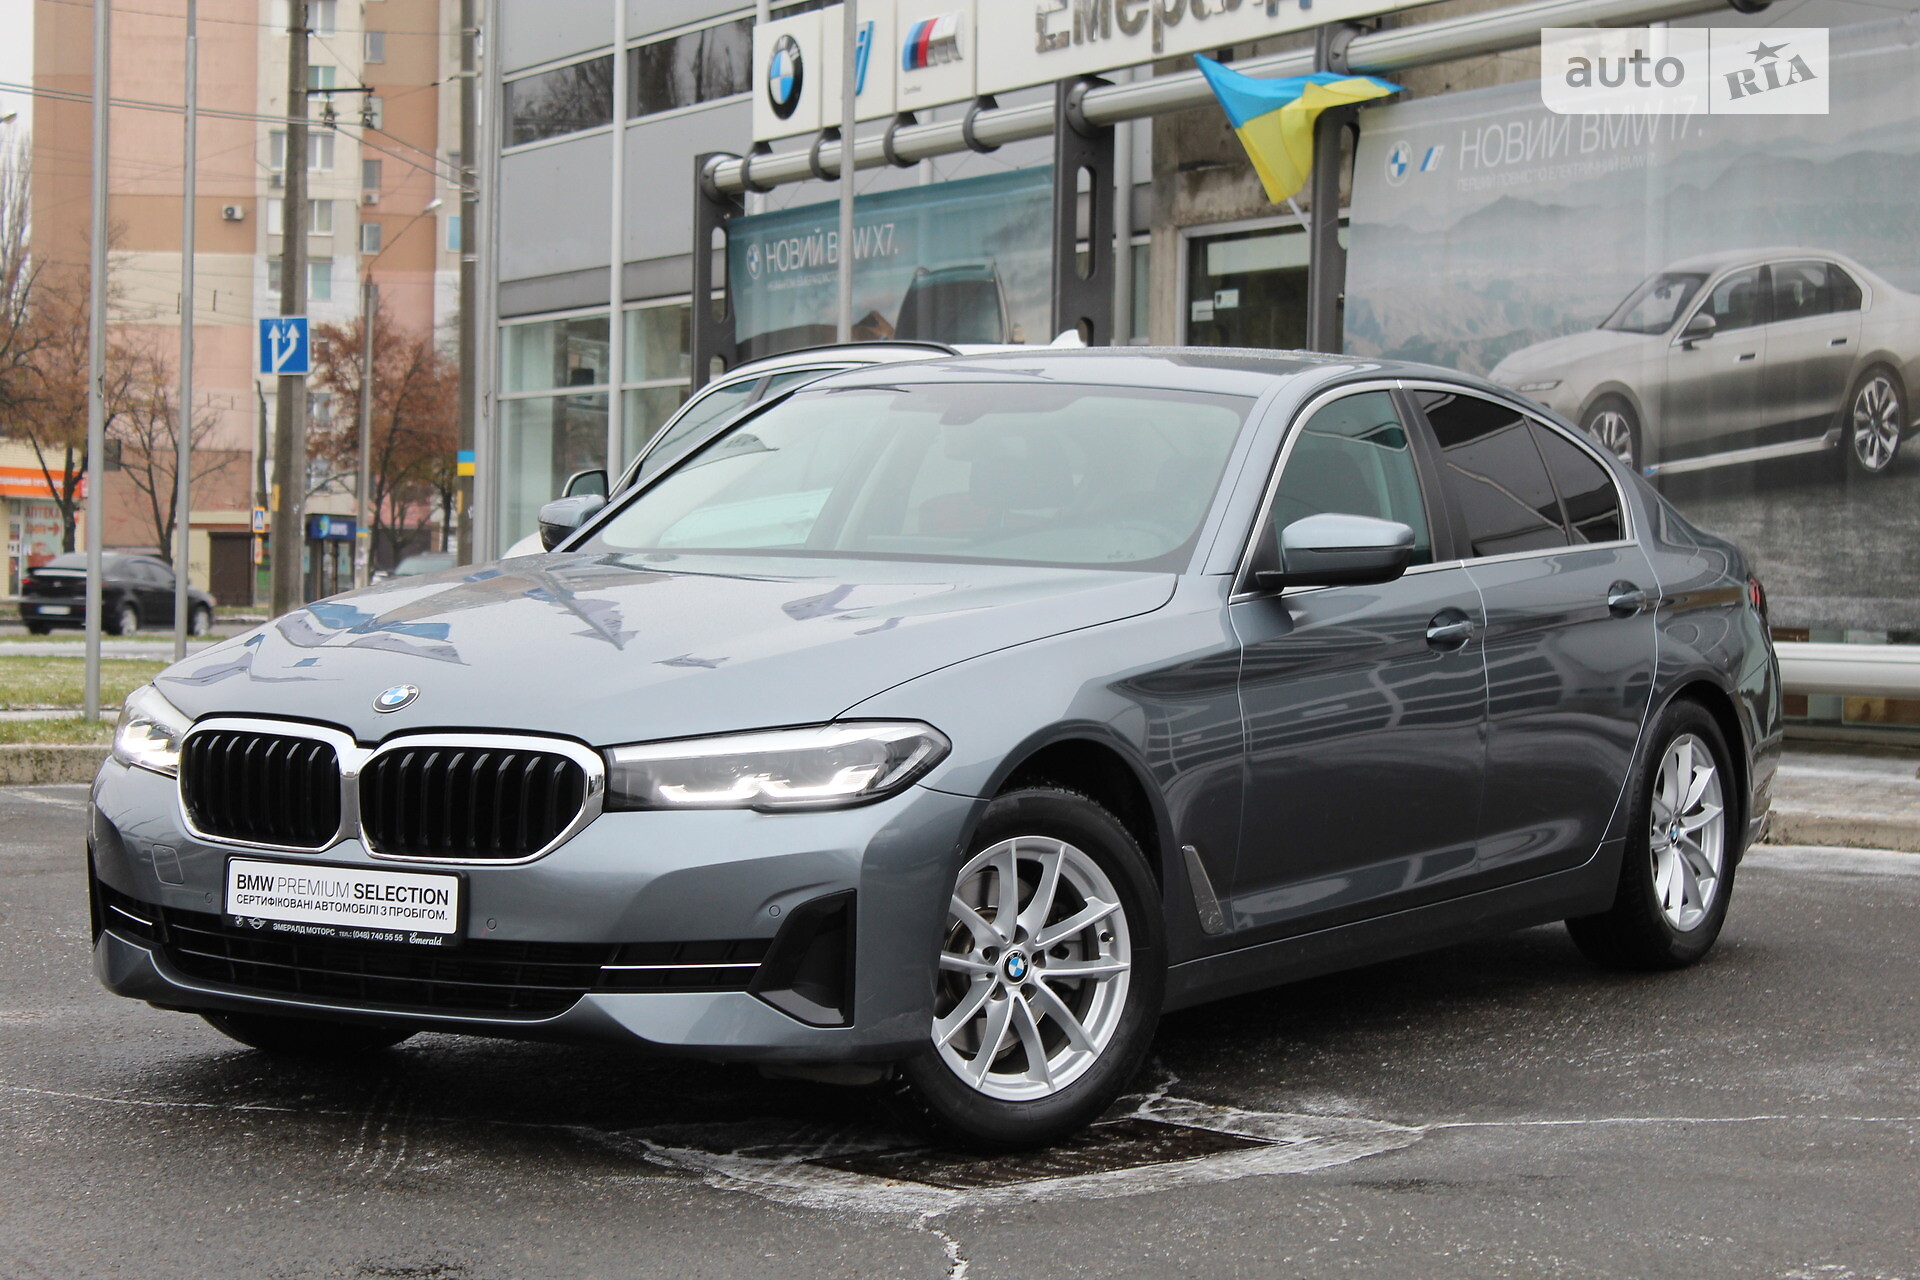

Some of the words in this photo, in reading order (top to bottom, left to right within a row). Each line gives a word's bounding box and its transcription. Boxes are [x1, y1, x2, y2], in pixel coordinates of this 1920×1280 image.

[1035, 0, 1312, 53] Емер
[1580, 95, 1662, 154] BMW
[766, 228, 824, 274] НОВИЙ
[827, 225, 871, 264] BW
[236, 894, 313, 910] СЕРТИФІКОВАНІ
[314, 901, 379, 915] АВТОМОБІЛІ
[389, 906, 448, 921] ПРОБІГОМ.
[237, 874, 274, 892] BMW
[277, 877, 349, 898] PREMIUM
[353, 883, 449, 906] SELECTION
[306, 926, 336, 936] МОТОРС
[370, 932, 384, 940] 740
[384, 933, 394, 941] 55
[394, 934, 403, 942] 55
[409, 932, 443, 946] Emerald
